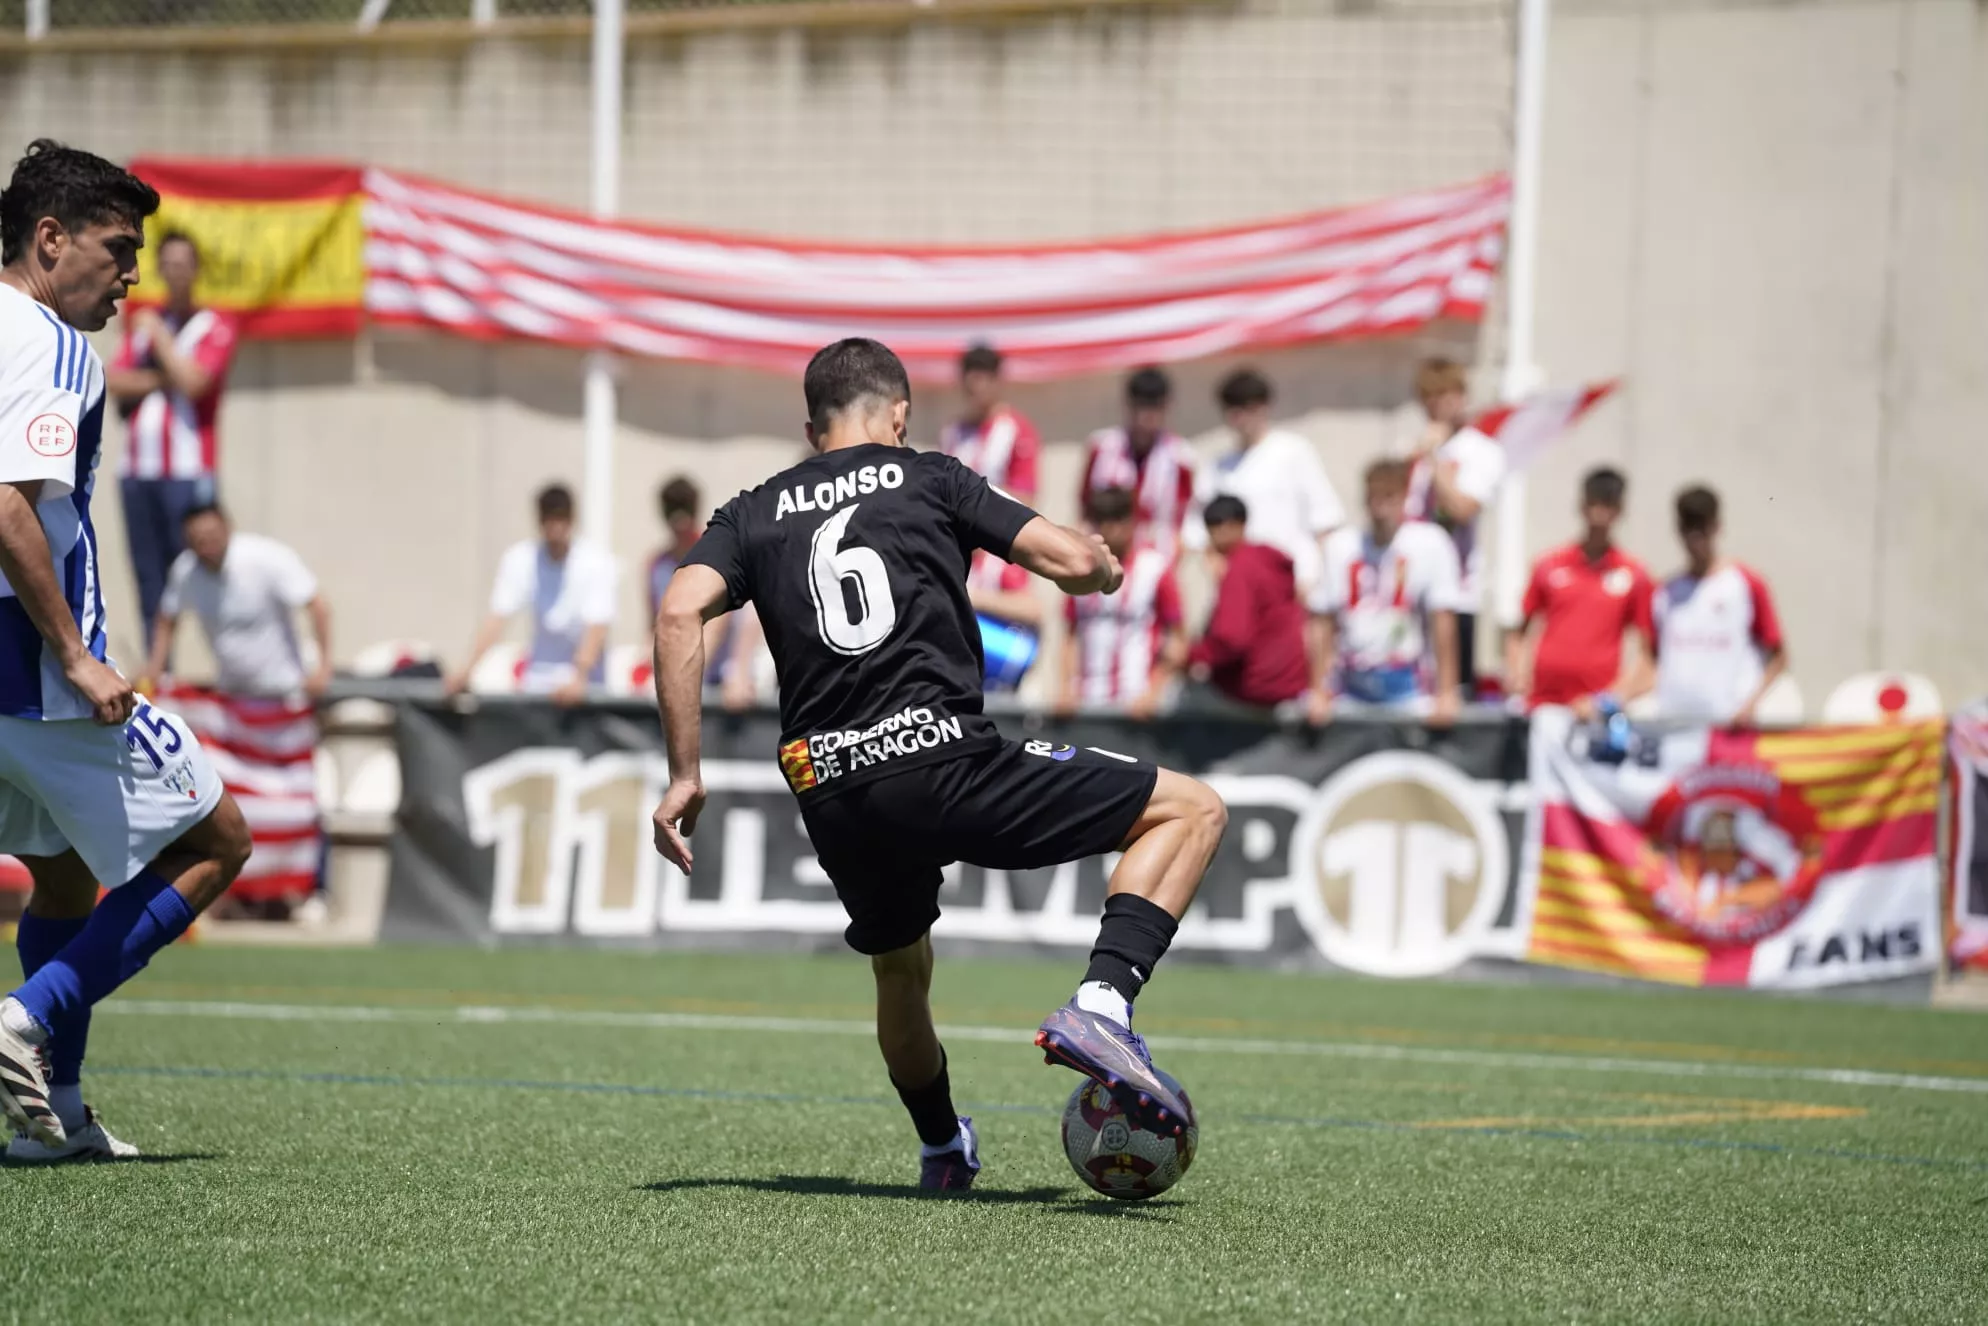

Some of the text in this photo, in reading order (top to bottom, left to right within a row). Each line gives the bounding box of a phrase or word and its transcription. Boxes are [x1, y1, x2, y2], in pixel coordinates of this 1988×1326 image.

[775, 463, 904, 521] ALONSO
[807, 503, 896, 656] 6
[127, 704, 182, 774] 15
[813, 754, 842, 784] DE
